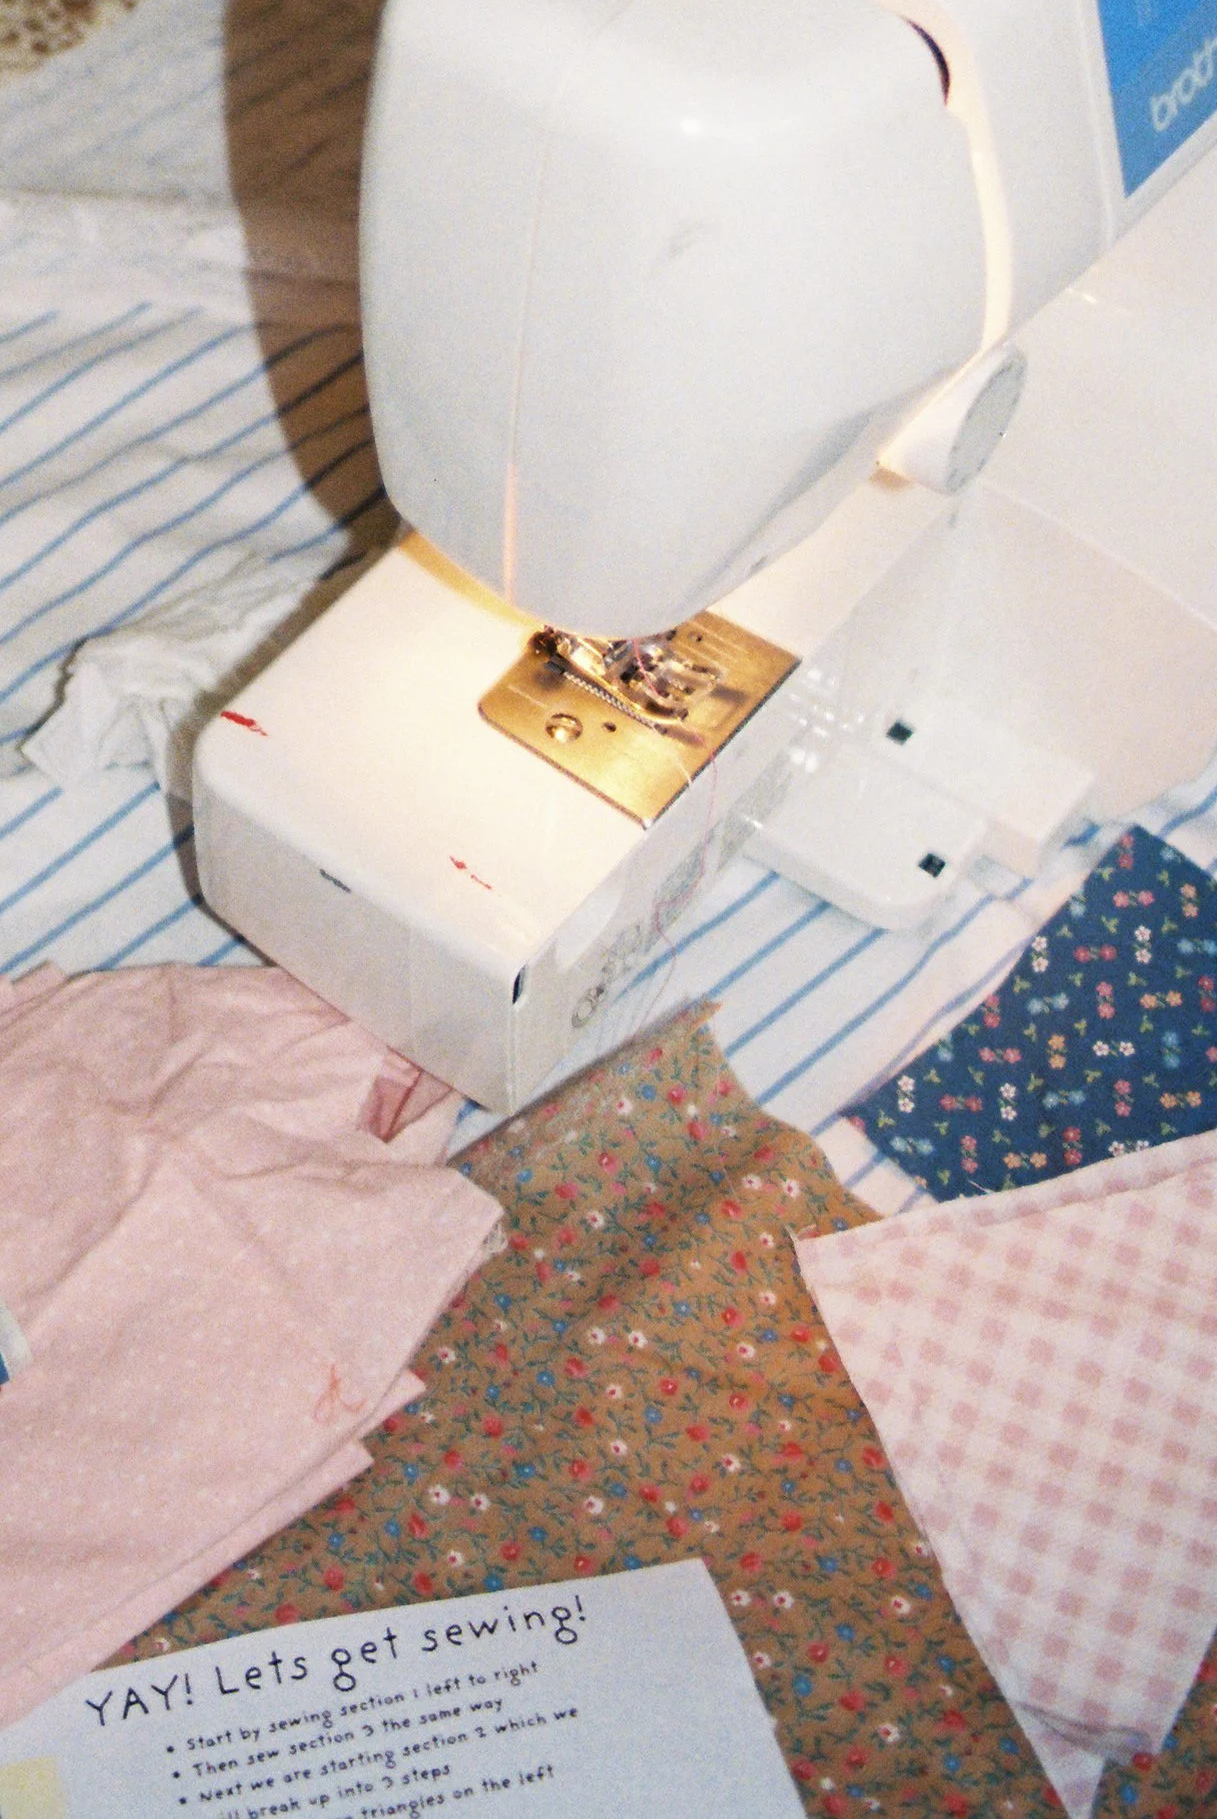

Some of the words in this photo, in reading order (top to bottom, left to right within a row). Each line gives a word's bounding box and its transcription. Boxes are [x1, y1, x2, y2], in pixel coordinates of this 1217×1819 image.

[85, 1672, 194, 1727] YAY!
[214, 1650, 309, 1695] Lets
[330, 1626, 398, 1693] get
[420, 1594, 587, 1653] sewing!
[187, 1730, 232, 1750] Start
[239, 1727, 260, 1743] by
[268, 1710, 333, 1733] sewing
[340, 1691, 404, 1717] section
[426, 1676, 461, 1697] left
[468, 1673, 486, 1686] to
[494, 1660, 537, 1687] right
[192, 1759, 238, 1777] Then
[247, 1749, 279, 1765] sew
[289, 1731, 354, 1755] section
[362, 1724, 374, 1737] 3
[382, 1717, 411, 1733] the
[419, 1706, 461, 1725] same
[469, 1697, 503, 1713] way
[199, 1782, 242, 1801] Next
[250, 1777, 274, 1791] we
[283, 1769, 311, 1783] are
[319, 1750, 397, 1776] starting
[403, 1733, 468, 1757] section
[474, 1726, 487, 1739] 2
[494, 1712, 547, 1733] which
[553, 1707, 577, 1720] we
[246, 1797, 301, 1819] break
[308, 1794, 330, 1809] up
[337, 1782, 374, 1798] into
[381, 1775, 394, 1789] 3
[402, 1764, 450, 1785] steps
[360, 1793, 445, 1819] triangles
[452, 1787, 474, 1800] on
[481, 1777, 511, 1792] the
[518, 1763, 554, 1786] left
